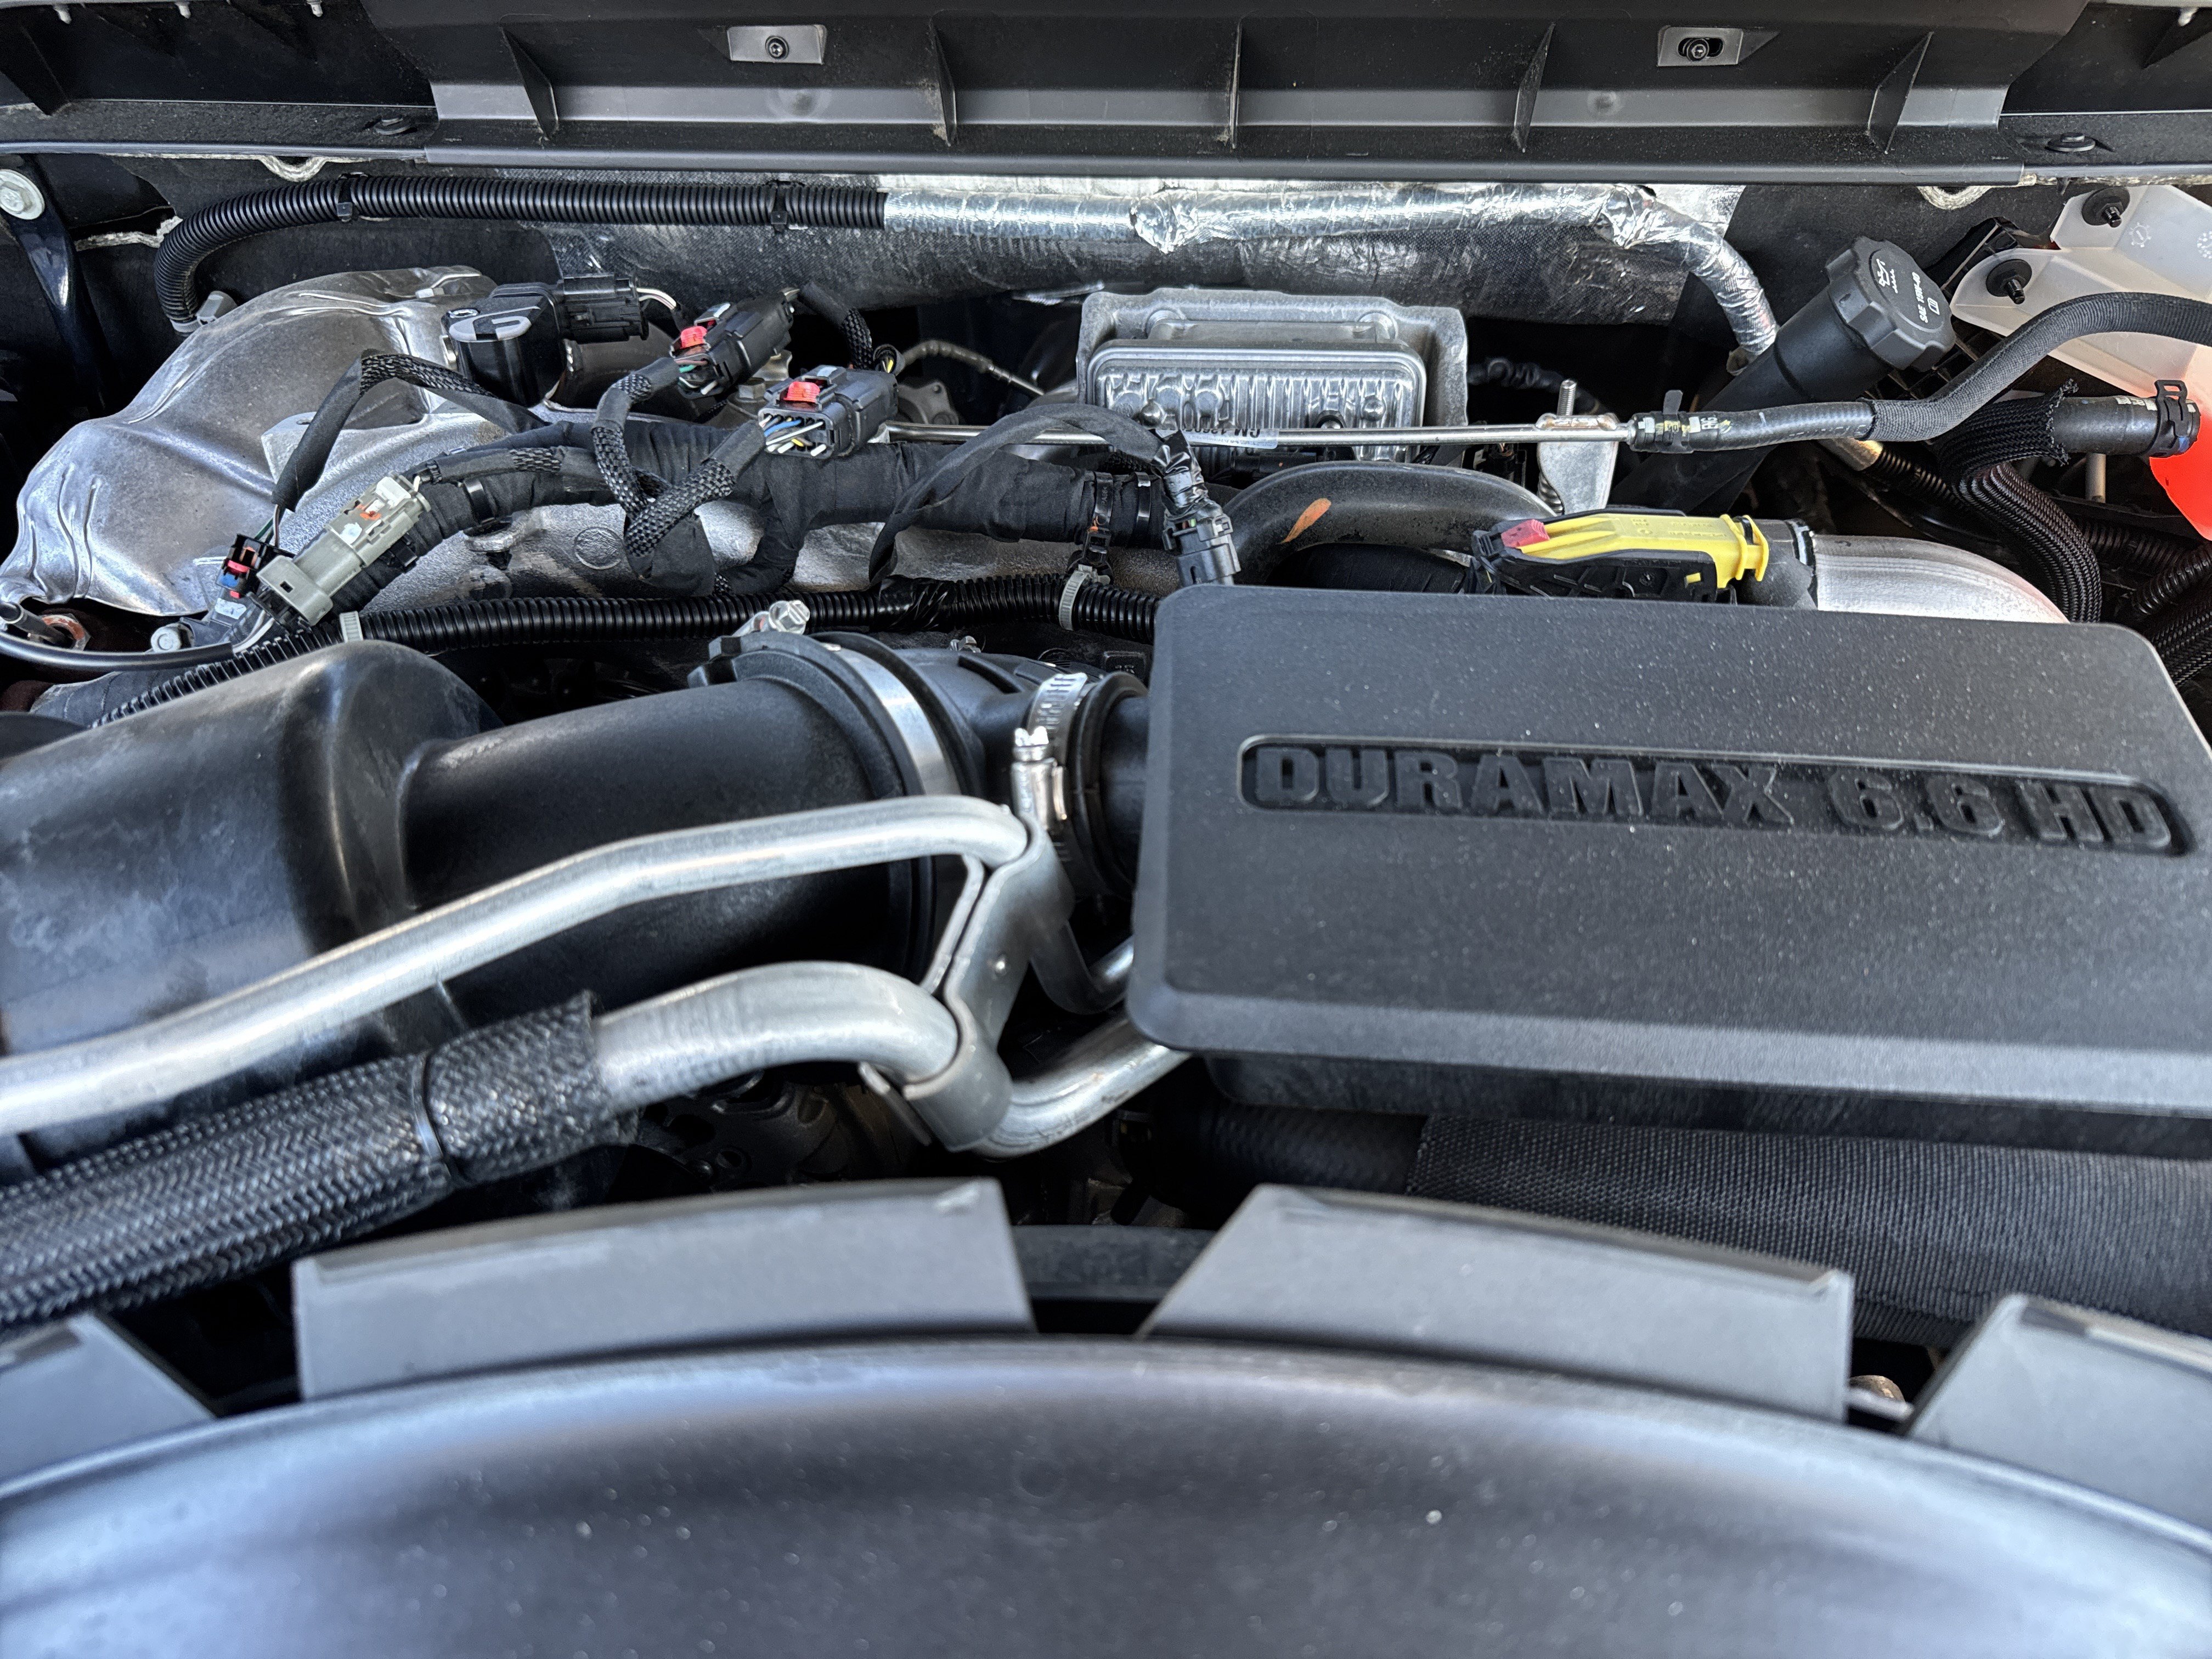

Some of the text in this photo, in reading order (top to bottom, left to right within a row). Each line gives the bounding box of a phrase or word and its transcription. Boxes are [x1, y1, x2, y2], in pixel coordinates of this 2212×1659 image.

[1912, 273, 1928, 323] SAE 15W-40
[1255, 747, 2172, 849] DURAMAX 6.6 HD
